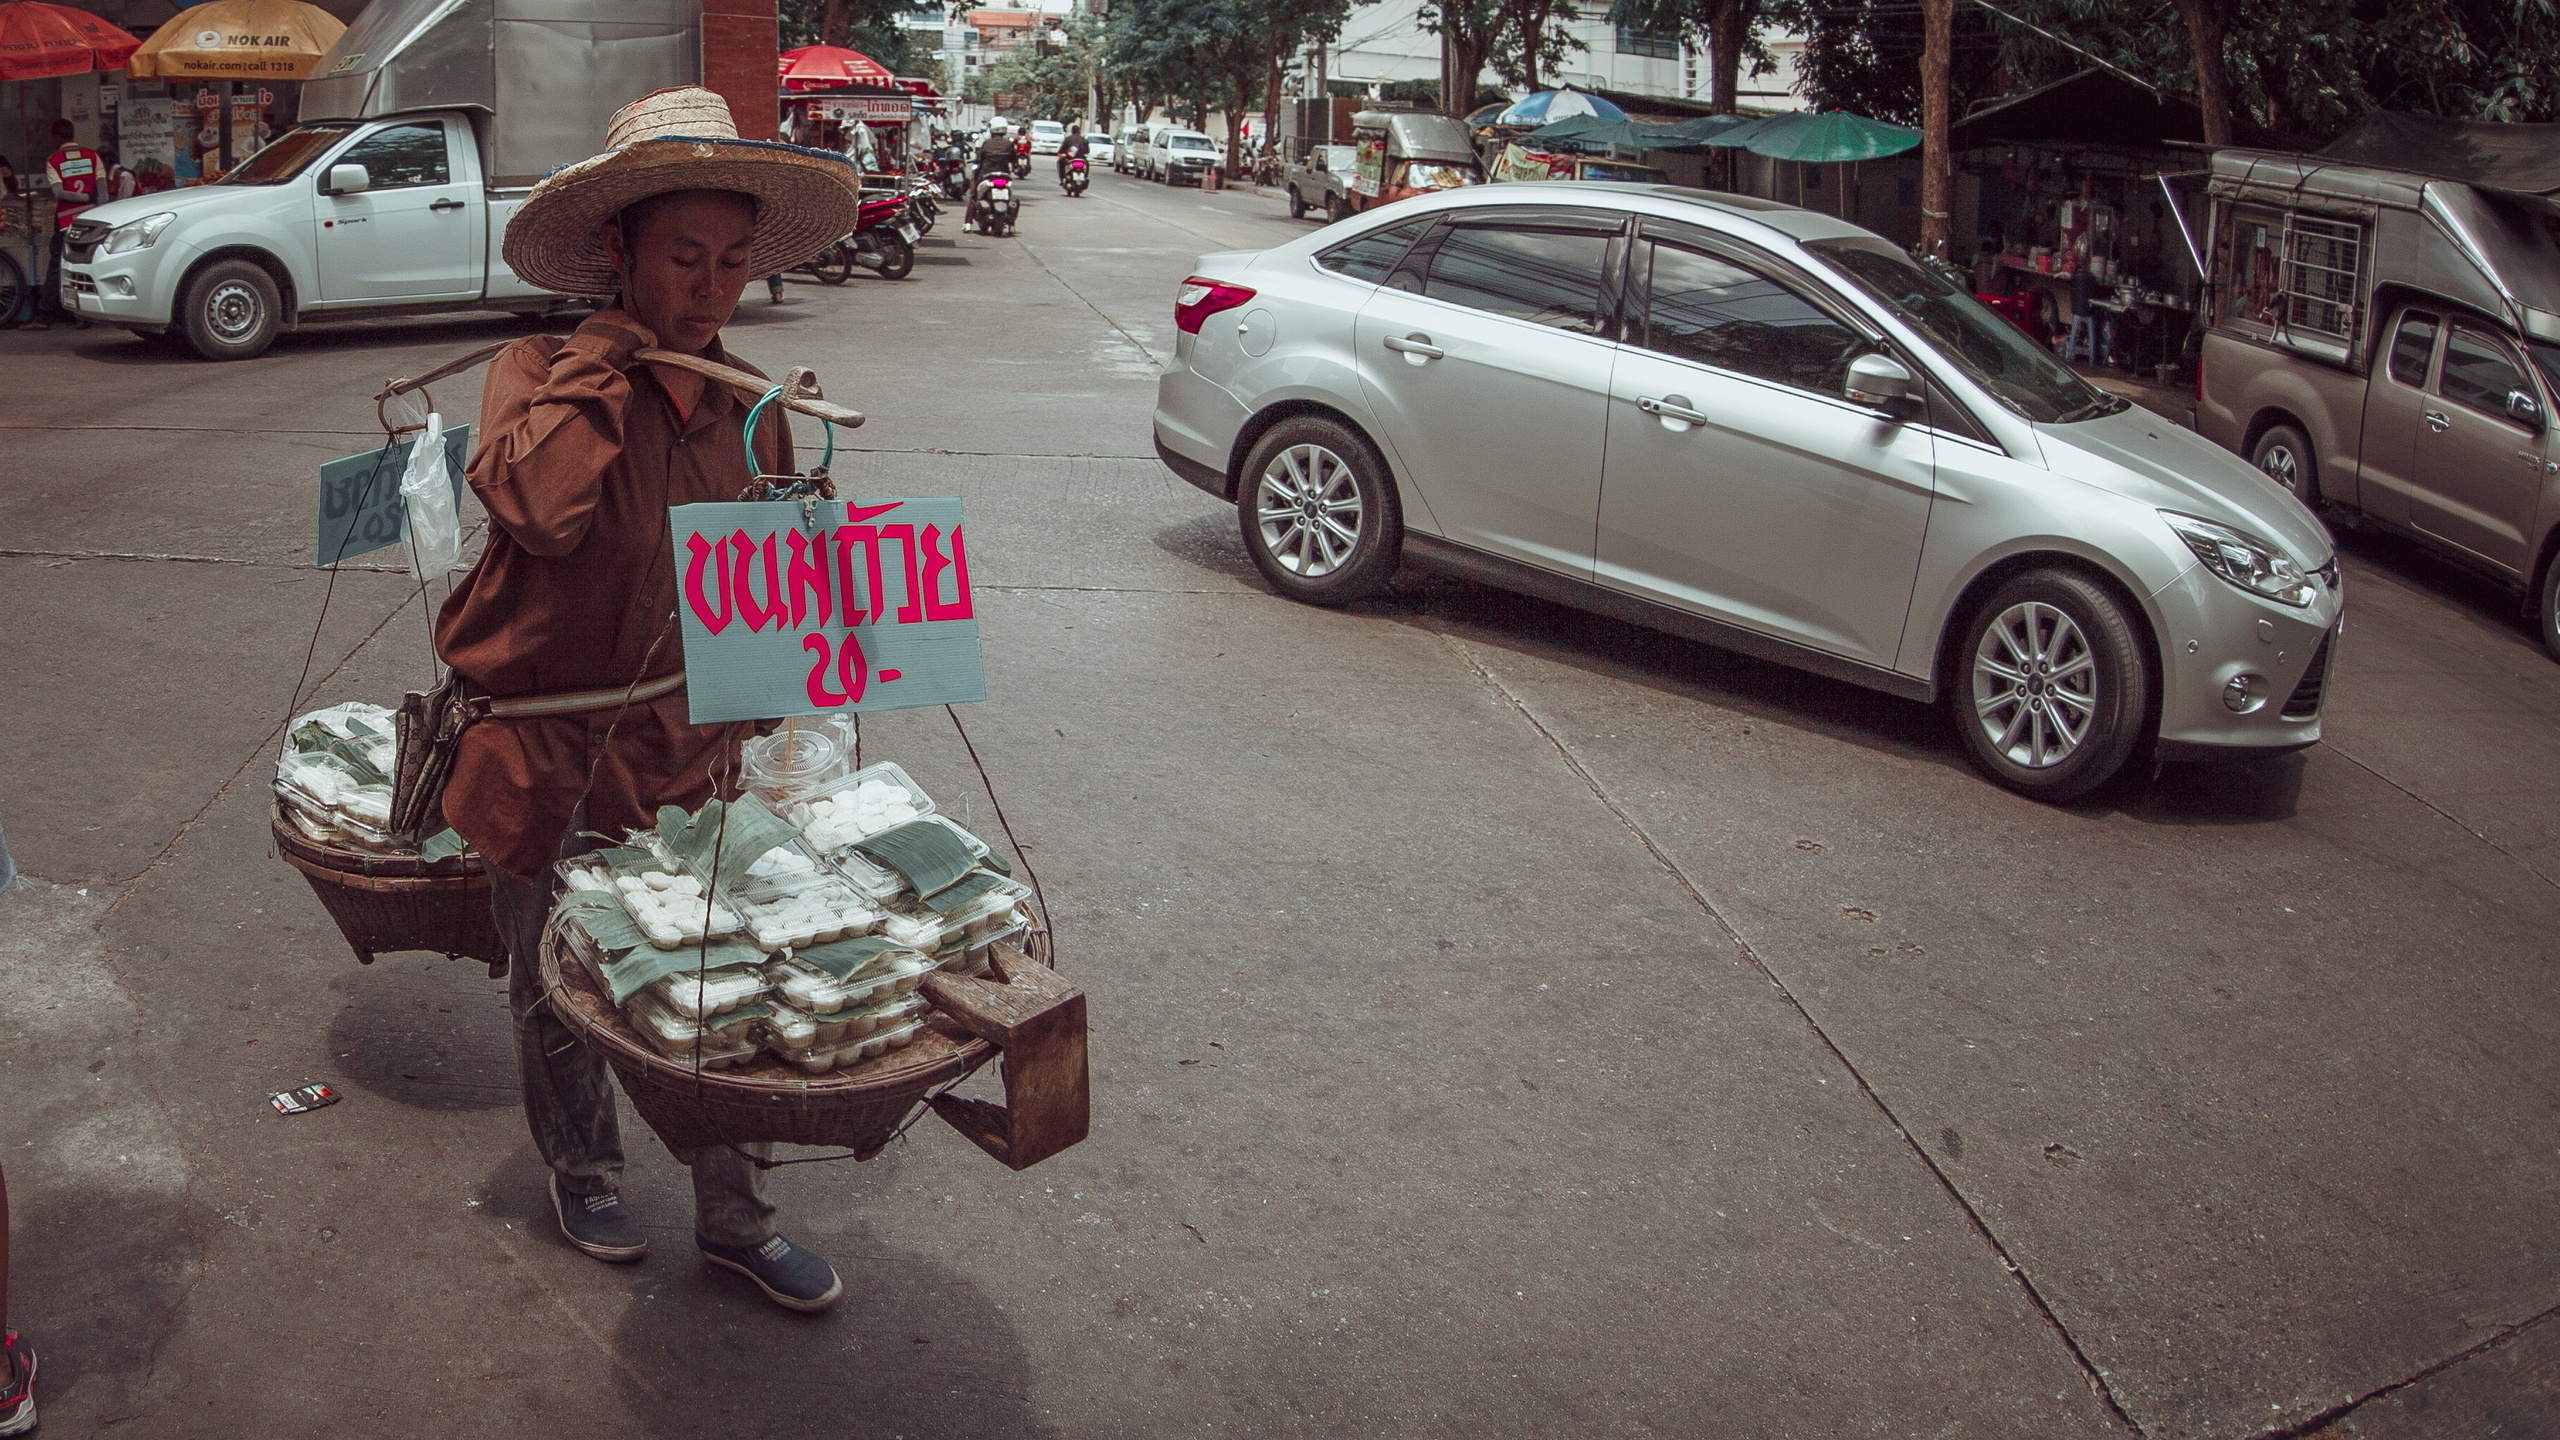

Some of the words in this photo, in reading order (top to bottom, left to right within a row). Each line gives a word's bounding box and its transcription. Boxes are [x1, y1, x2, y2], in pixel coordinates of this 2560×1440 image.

[227, 34, 260, 47] NOK
[263, 35, 291, 47] AIR
[183, 60, 242, 72] nokair.com
[248, 61, 267, 72] call
[270, 62, 294, 72] 1318
[684, 500, 974, 637] ขนมถ้วย
